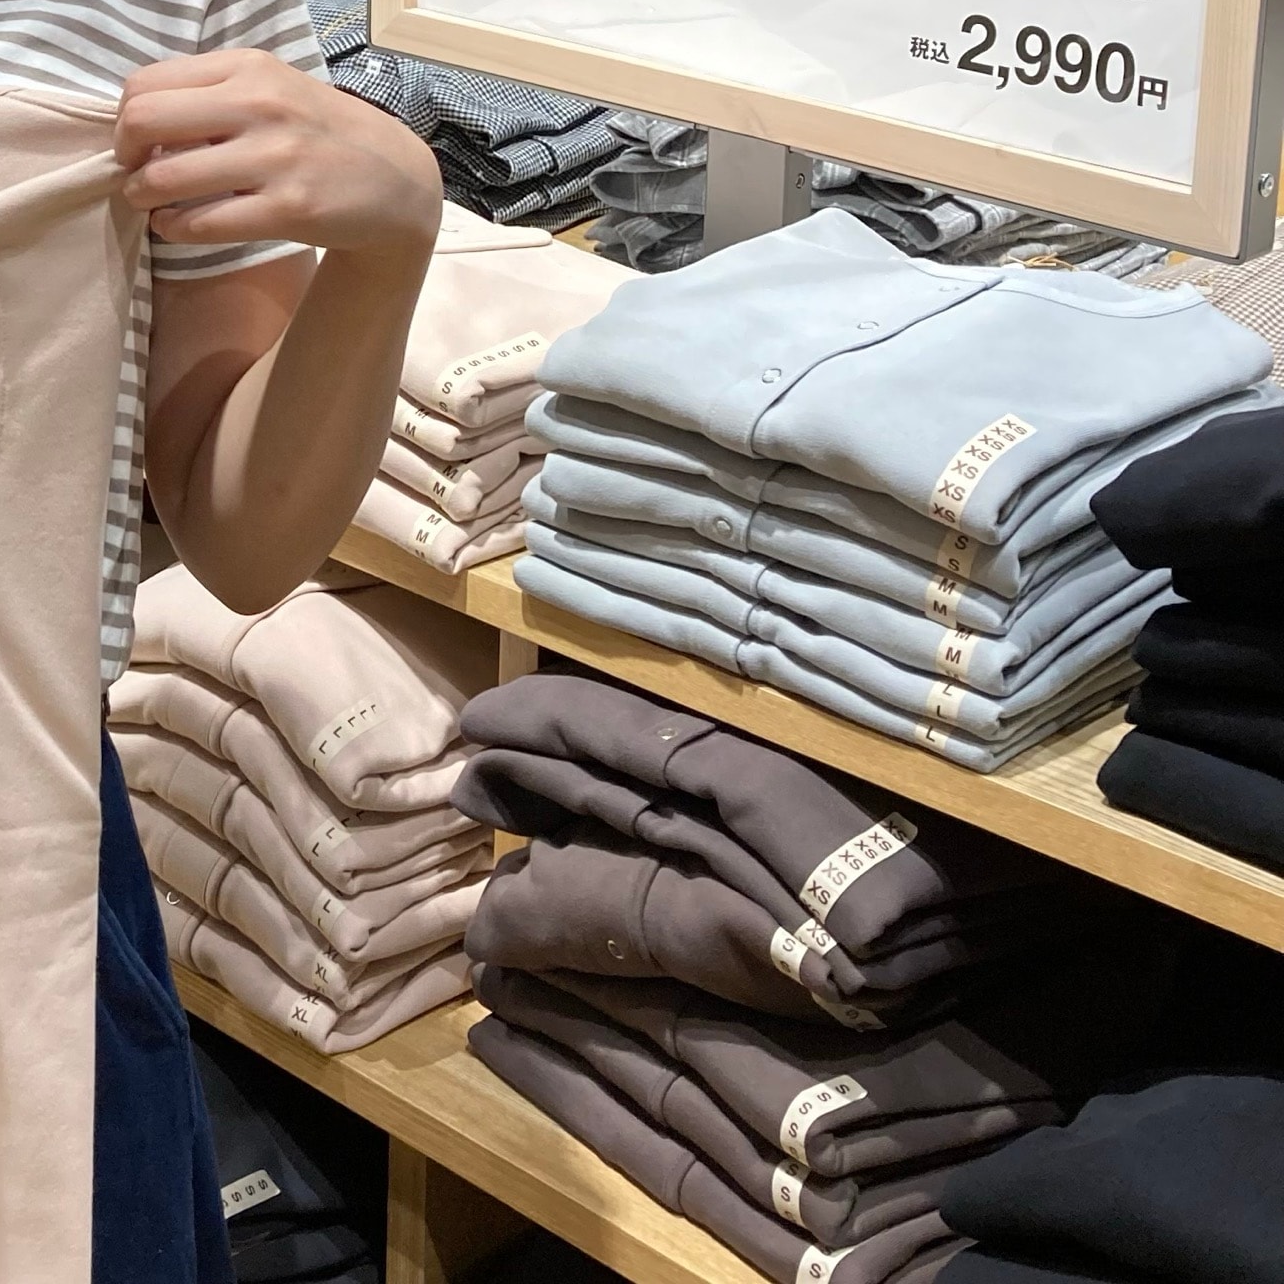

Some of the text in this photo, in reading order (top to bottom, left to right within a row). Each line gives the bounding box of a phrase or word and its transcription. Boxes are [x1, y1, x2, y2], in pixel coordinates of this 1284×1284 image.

[527, 339, 540, 347] S
[498, 350, 510, 358] S
[454, 366, 466, 376] S
[442, 382, 452, 394] S
[404, 422, 416, 437] M
[933, 419, 1028, 524] XS XS XS XS XS XS XS
[432, 465, 458, 498] M M
[426, 514, 442, 526] M
[416, 529, 430, 544] M
[948, 535, 968, 572] S S
[933, 578, 956, 616] M M
[946, 646, 962, 664] M
[942, 683, 953, 696] L
[937, 705, 948, 720] L
[926, 726, 936, 742] L
[326, 827, 335, 839] L
[312, 842, 320, 856] L
[807, 820, 907, 904] XS XS XS XS XS XS
[323, 899, 331, 913] L
[807, 924, 830, 947] XS
[782, 938, 796, 952] S
[315, 963, 328, 984] XL
[292, 1006, 308, 1024] XL
[788, 1084, 850, 1138] S S S S
[786, 1164, 799, 1176] S
[232, 1179, 268, 1202] S S S
[780, 1186, 790, 1202] S
[809, 1262, 822, 1279] S
